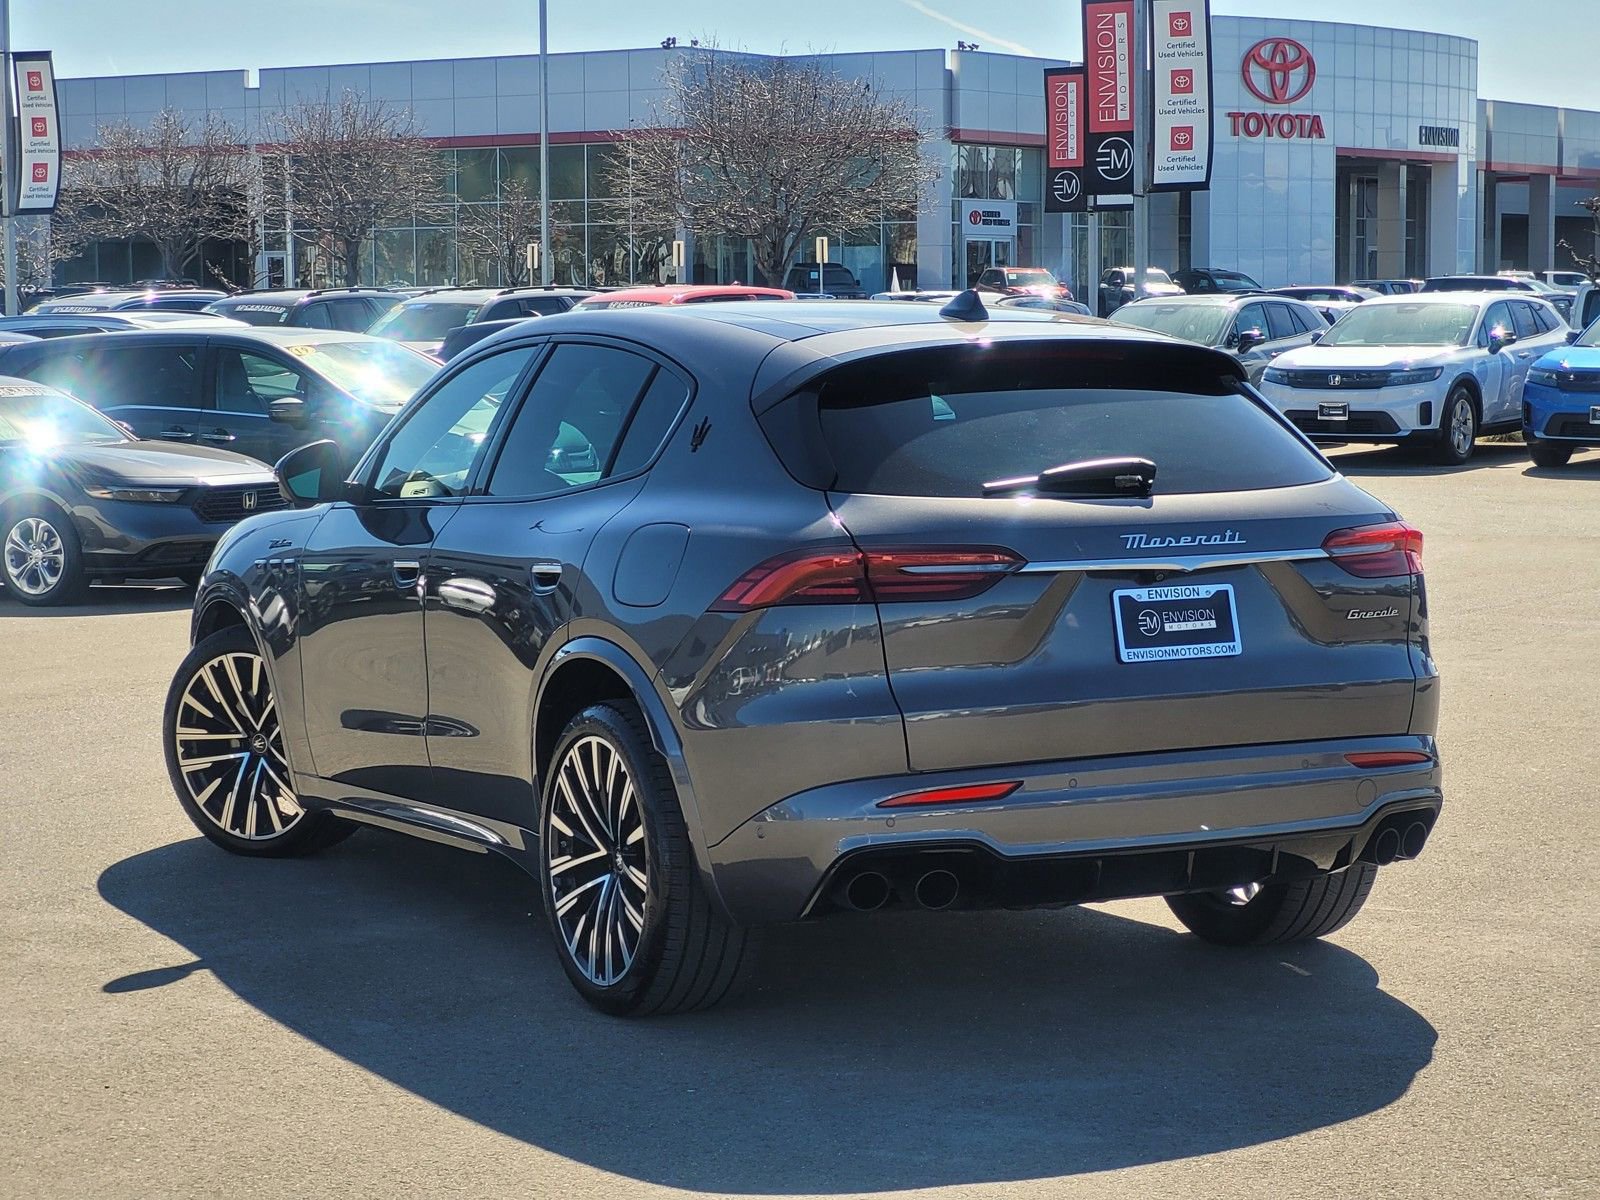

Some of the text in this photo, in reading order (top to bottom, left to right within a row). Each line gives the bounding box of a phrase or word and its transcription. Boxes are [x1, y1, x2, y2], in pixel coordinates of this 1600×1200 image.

[1166, 41, 1196, 49] Certified
[1096, 13, 1116, 122] ENVISION
[1117, 22, 1128, 112] MOTORS
[1167, 98, 1197, 106] Certified
[1158, 107, 1176, 115] Used
[1054, 82, 1068, 160] ENVISION
[1225, 112, 1326, 139] TOYOTA
[1418, 125, 1460, 147] ENVISION
[1166, 155, 1196, 163] Certified
[1176, 163, 1204, 171] Vehicles
[1120, 529, 1247, 549] Maserati
[1147, 587, 1200, 600] ENVISION
[1162, 609, 1216, 623] ENVISION
[1347, 606, 1399, 619] Grecale
[1168, 621, 1213, 630] MOTORS
[1126, 644, 1237, 660] ENVISIONMOTORS.COM
